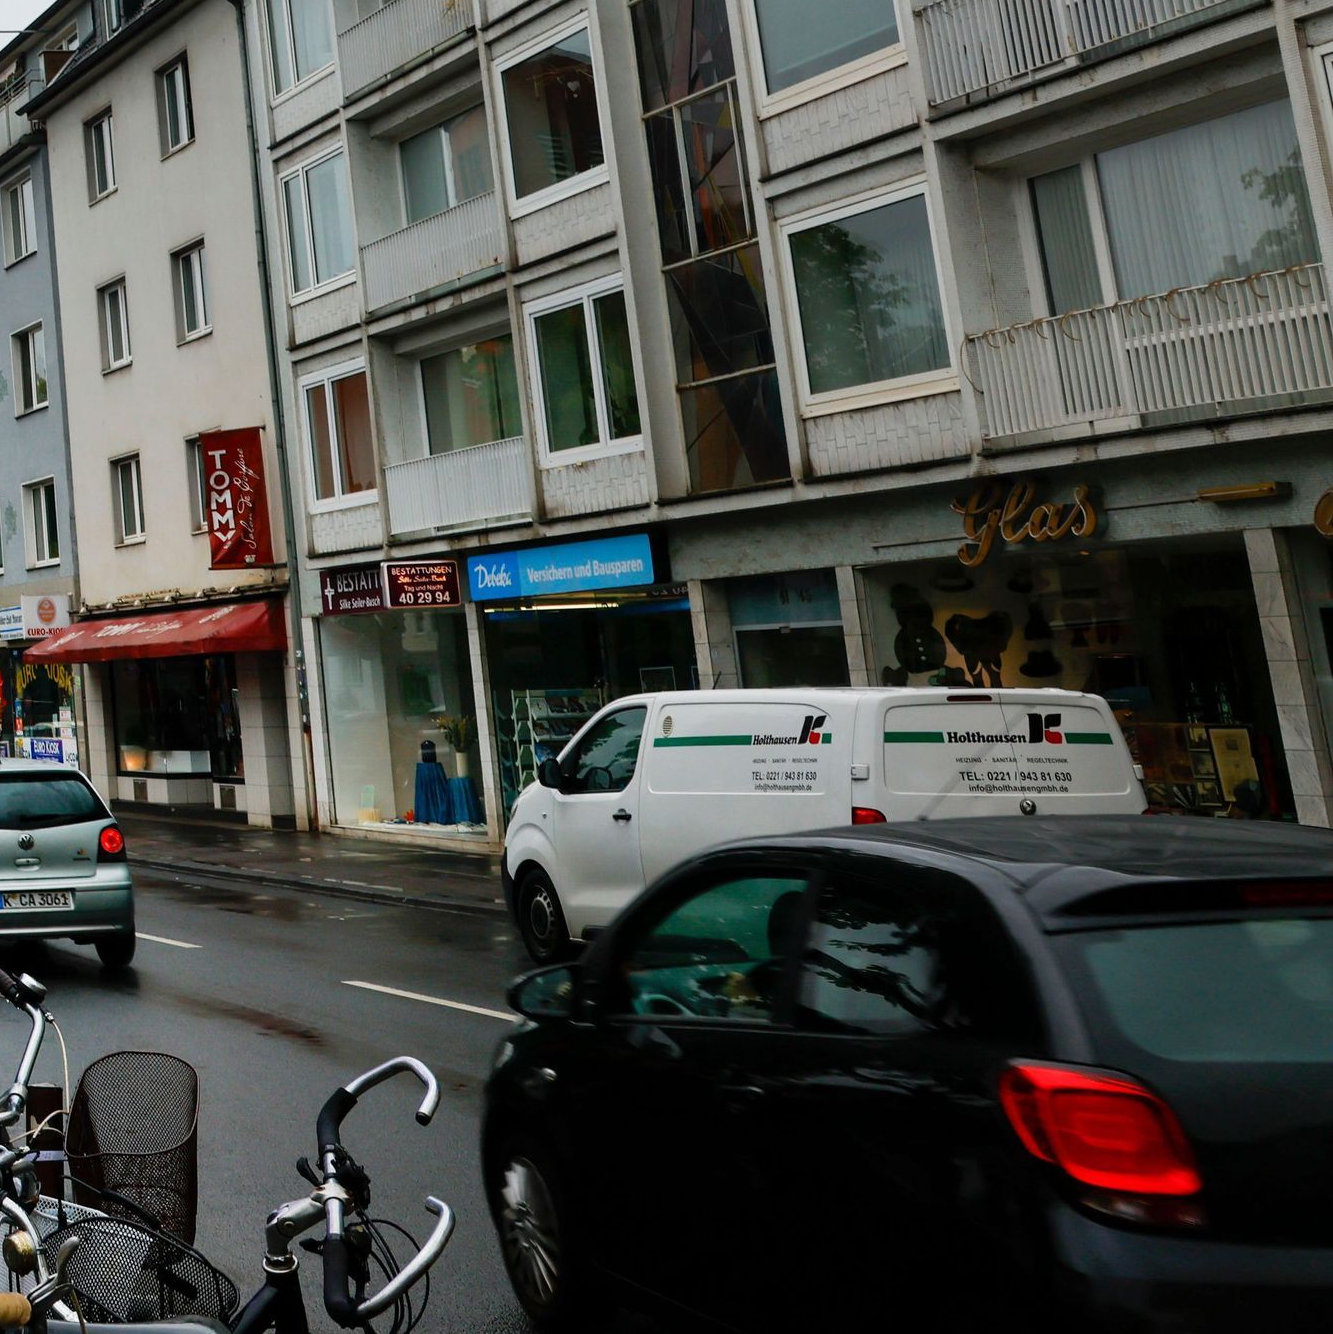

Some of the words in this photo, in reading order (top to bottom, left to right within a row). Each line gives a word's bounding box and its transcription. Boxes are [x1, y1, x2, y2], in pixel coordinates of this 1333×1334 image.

[949, 479, 1099, 568] Glas
[391, 566, 452, 576] BESTATTUNGEN
[474, 562, 512, 588] Debeka
[527, 564, 573, 583] Versichern
[574, 562, 592, 578] und
[593, 558, 643, 580] Bausparen
[336, 569, 382, 593] BESTATT
[339, 598, 351, 610] Silke
[352, 596, 381, 609] Seiler-Busch
[399, 592, 414, 604] 40
[418, 592, 432, 604] 29
[435, 591, 450, 603] 94
[753, 733, 797, 745] Holthausen
[946, 731, 1027, 744] Holthausen
[34, 740, 46, 753] EURO
[46, 741, 60, 754] KIOSK
[752, 771, 765, 781] TEL:
[766, 771, 780, 781] 0221
[784, 771, 795, 780] 943
[797, 771, 804, 780] 81
[805, 771, 817, 780] 630
[959, 771, 984, 781] TEL:
[987, 771, 1011, 781] 0221
[1020, 771, 1038, 781] 943
[1041, 771, 1052, 781] 81
[1055, 772, 1072, 782] 630
[754, 783, 812, 793] info@holthausengmbh.de
[969, 784, 1069, 794] info@holthausengmbh.de
[4, 894, 13, 907] K
[19, 894, 37, 907] CA
[38, 893, 70, 907] 3061
